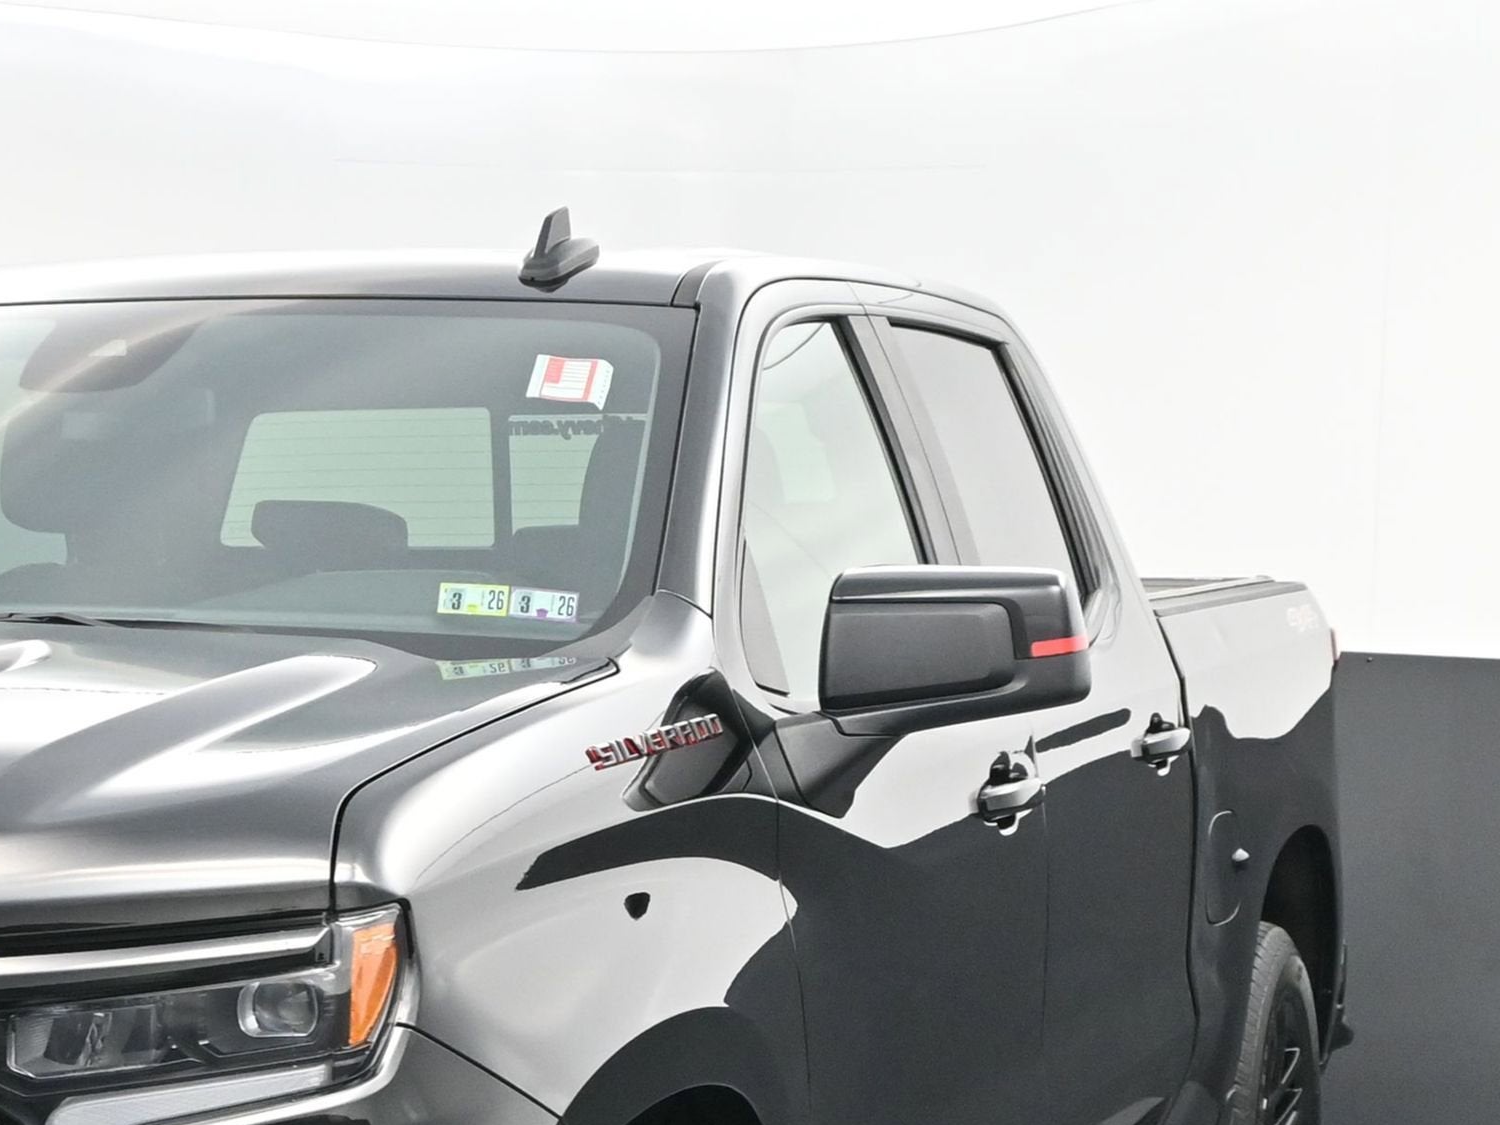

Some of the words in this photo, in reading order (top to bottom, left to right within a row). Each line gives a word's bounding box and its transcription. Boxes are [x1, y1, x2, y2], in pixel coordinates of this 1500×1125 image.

[451, 592, 463, 610] 3
[487, 590, 505, 610] 26
[520, 595, 531, 613] 3
[558, 595, 576, 617] 26
[585, 713, 724, 771] SILVERADO
